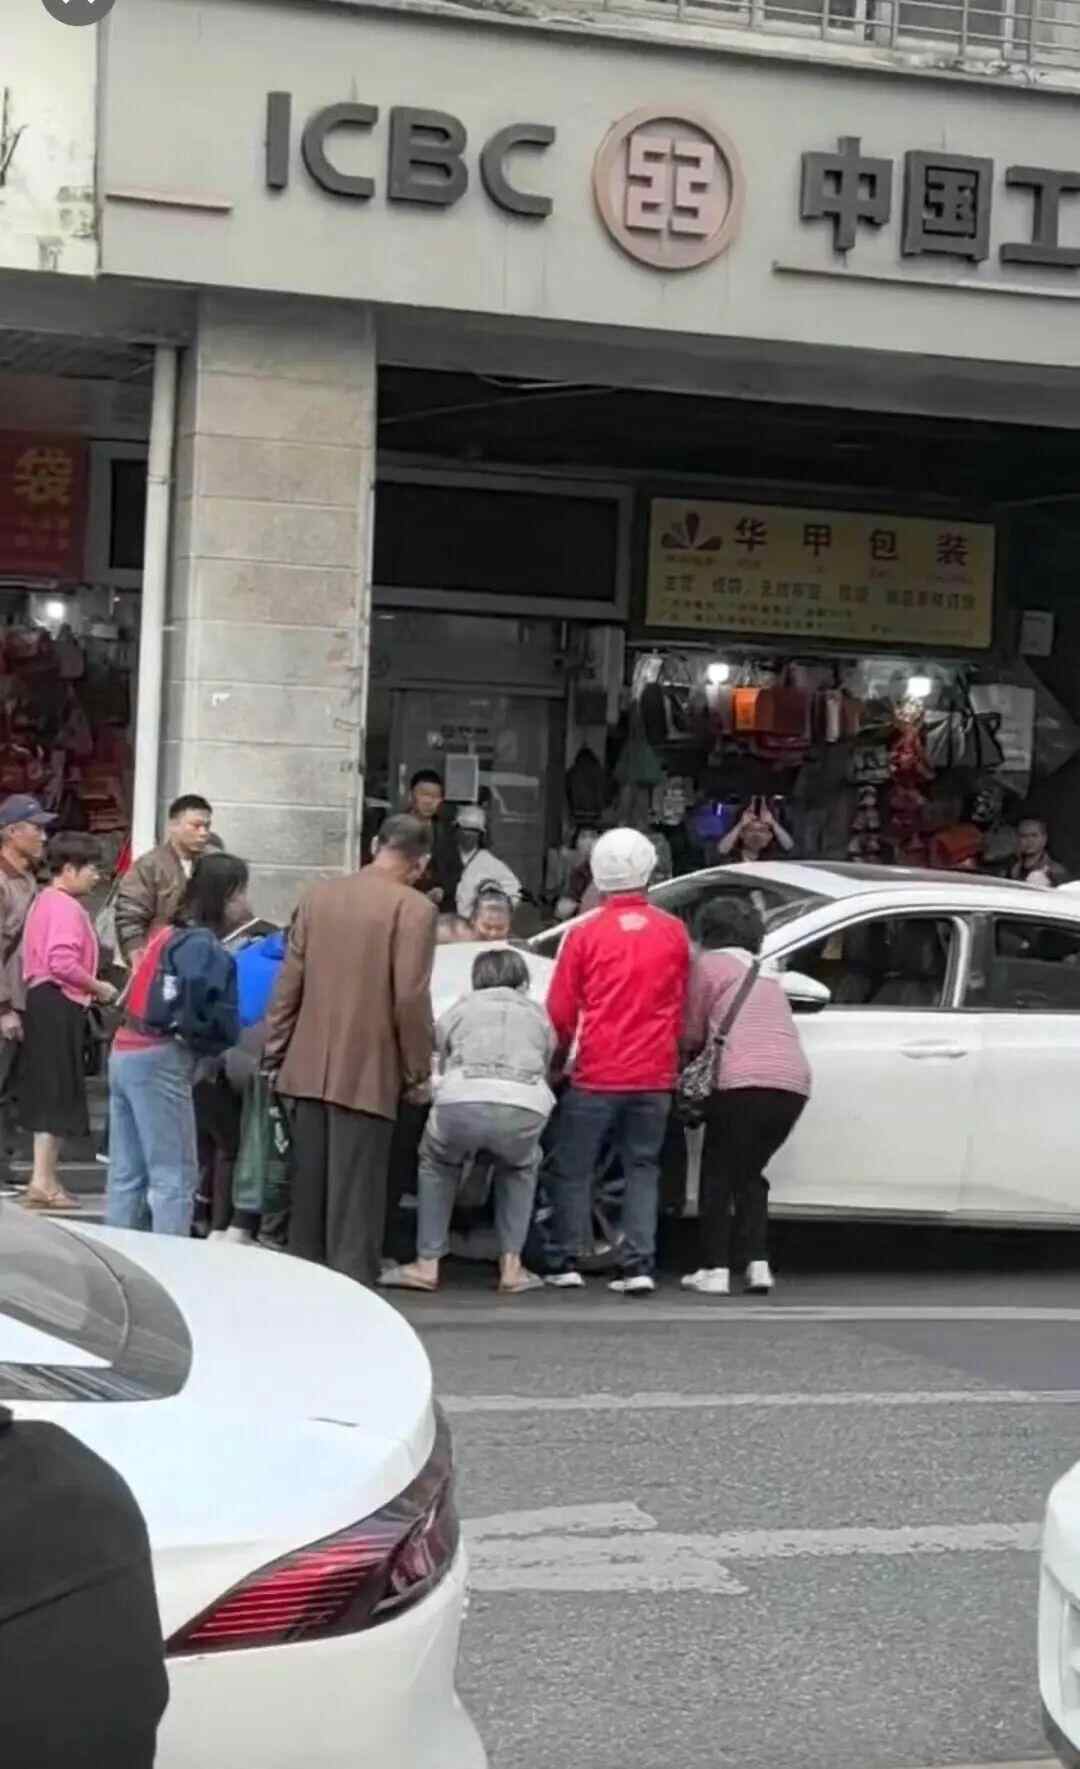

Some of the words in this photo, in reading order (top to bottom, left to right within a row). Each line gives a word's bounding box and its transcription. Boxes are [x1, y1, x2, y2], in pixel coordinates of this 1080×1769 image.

[265, 91, 557, 218] ICBC
[800, 135, 1080, 268] 中国工
[735, 515, 969, 567] 华甲包装
